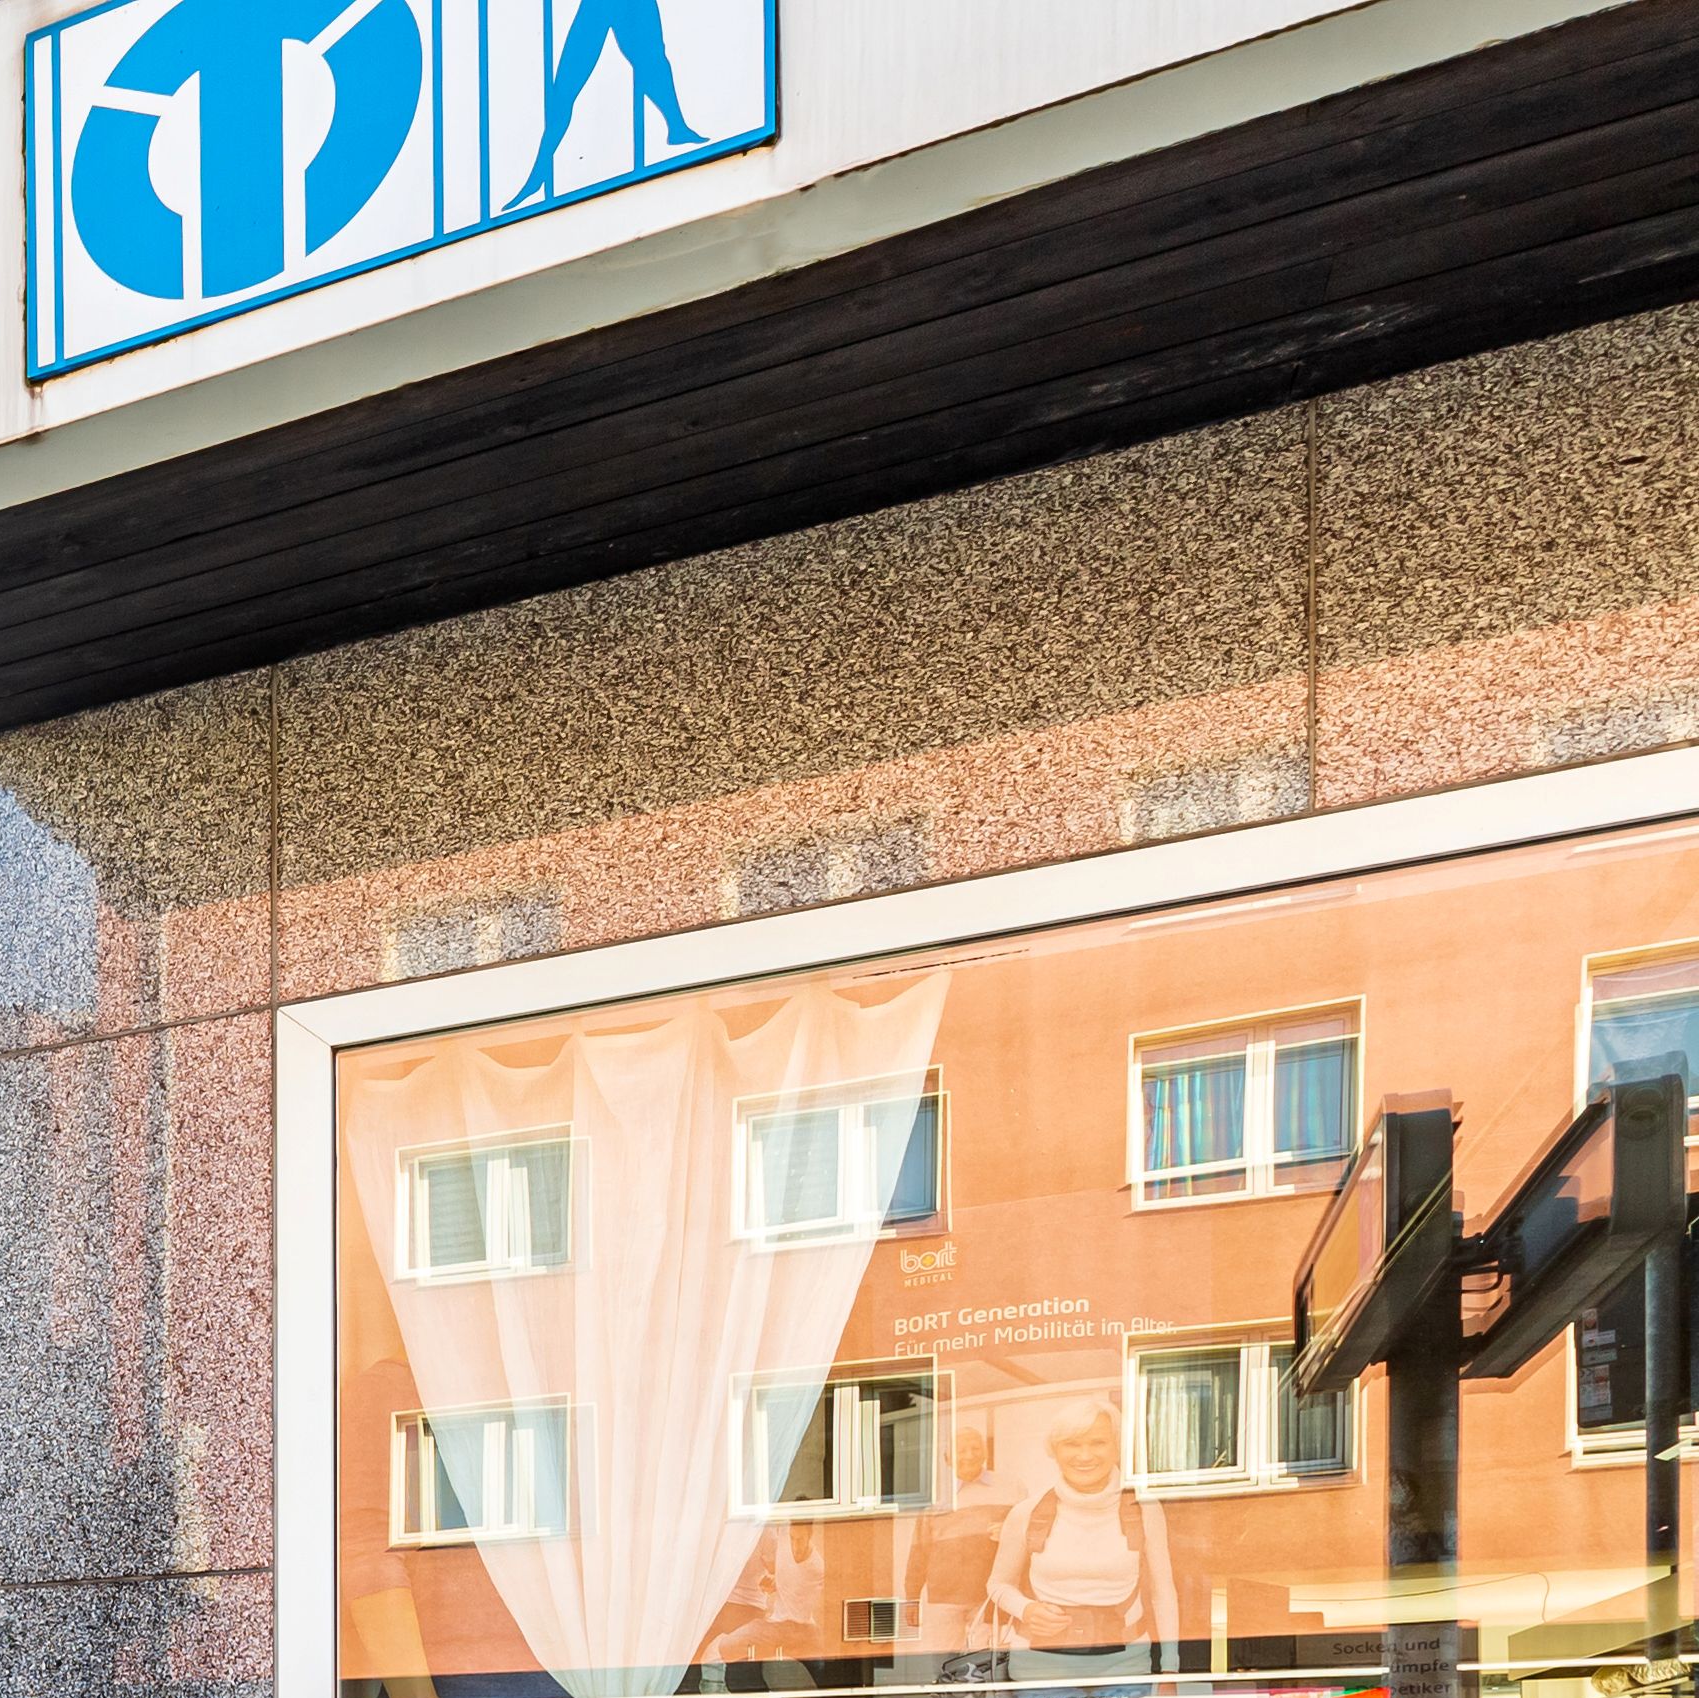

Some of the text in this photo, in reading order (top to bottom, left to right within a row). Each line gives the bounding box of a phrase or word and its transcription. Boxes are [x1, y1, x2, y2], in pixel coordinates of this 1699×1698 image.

[904, 1272, 954, 1287] MEDICAL
[894, 1296, 1090, 1336] BORT Generation
[893, 1340, 927, 1357] Für
[932, 1331, 987, 1355] mehr
[993, 1318, 1095, 1346] Mobilität
[1100, 1317, 1125, 1336] im
[1405, 1637, 1441, 1651] und
